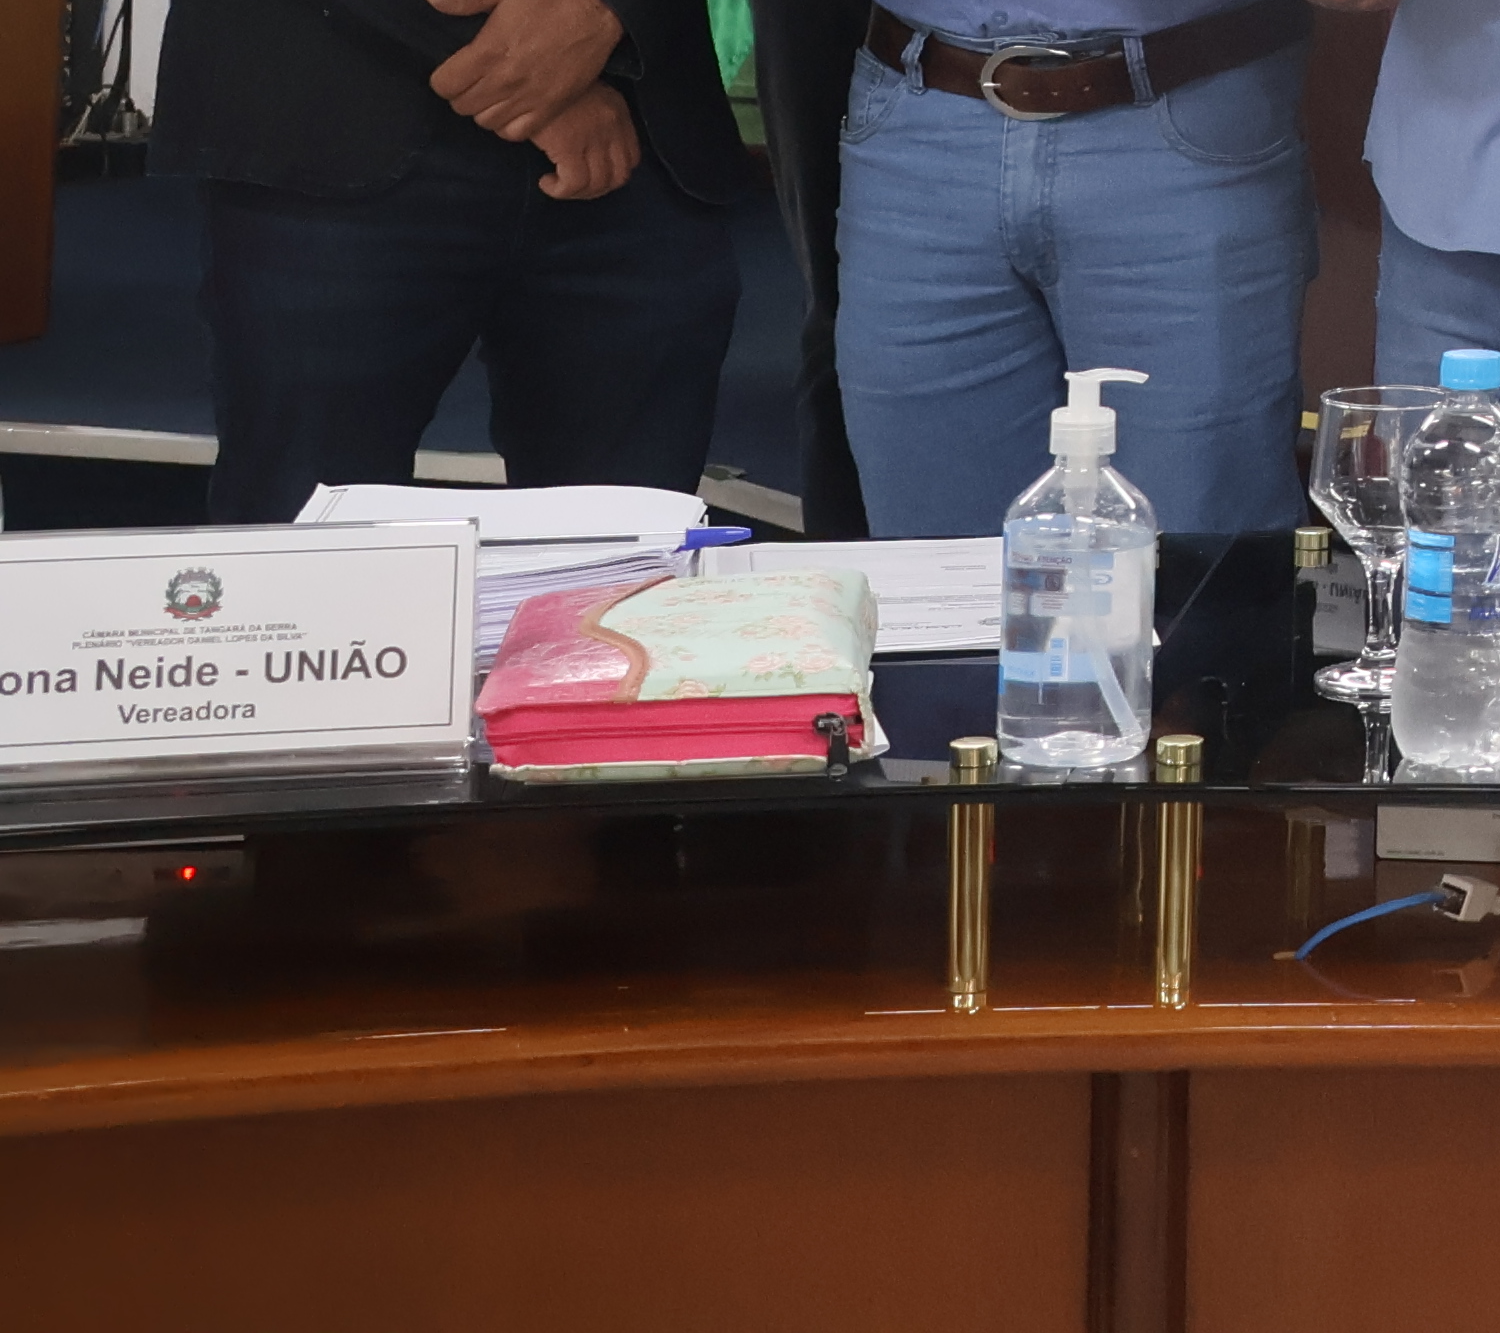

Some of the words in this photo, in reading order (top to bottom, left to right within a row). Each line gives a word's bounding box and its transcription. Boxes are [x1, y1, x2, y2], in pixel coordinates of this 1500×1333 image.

[0, 670, 77, 697] ona
[96, 655, 218, 691] Neide
[265, 640, 406, 684] UNIÃO
[118, 700, 255, 724] Vereadora
